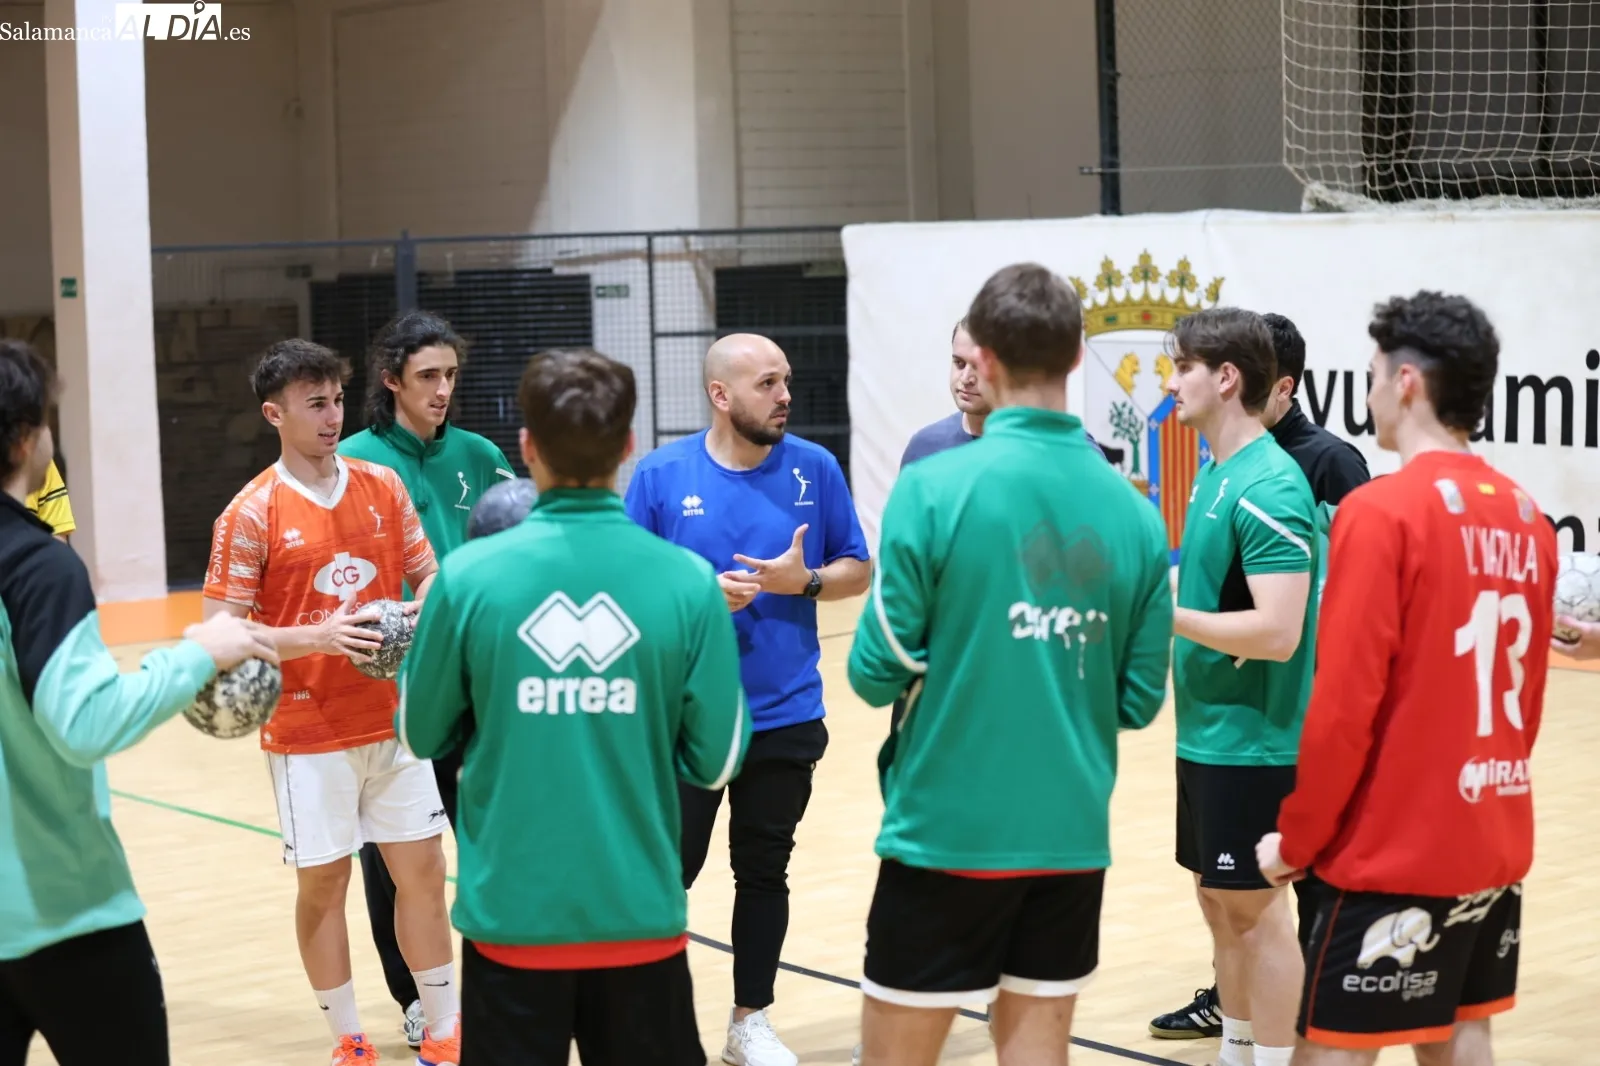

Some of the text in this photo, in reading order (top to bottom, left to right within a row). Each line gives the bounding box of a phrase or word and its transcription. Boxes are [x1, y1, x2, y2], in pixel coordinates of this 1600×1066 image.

[683, 507, 705, 518] errea
[331, 565, 360, 587] CG
[1454, 590, 1533, 738] 13
[517, 676, 636, 715] errea
